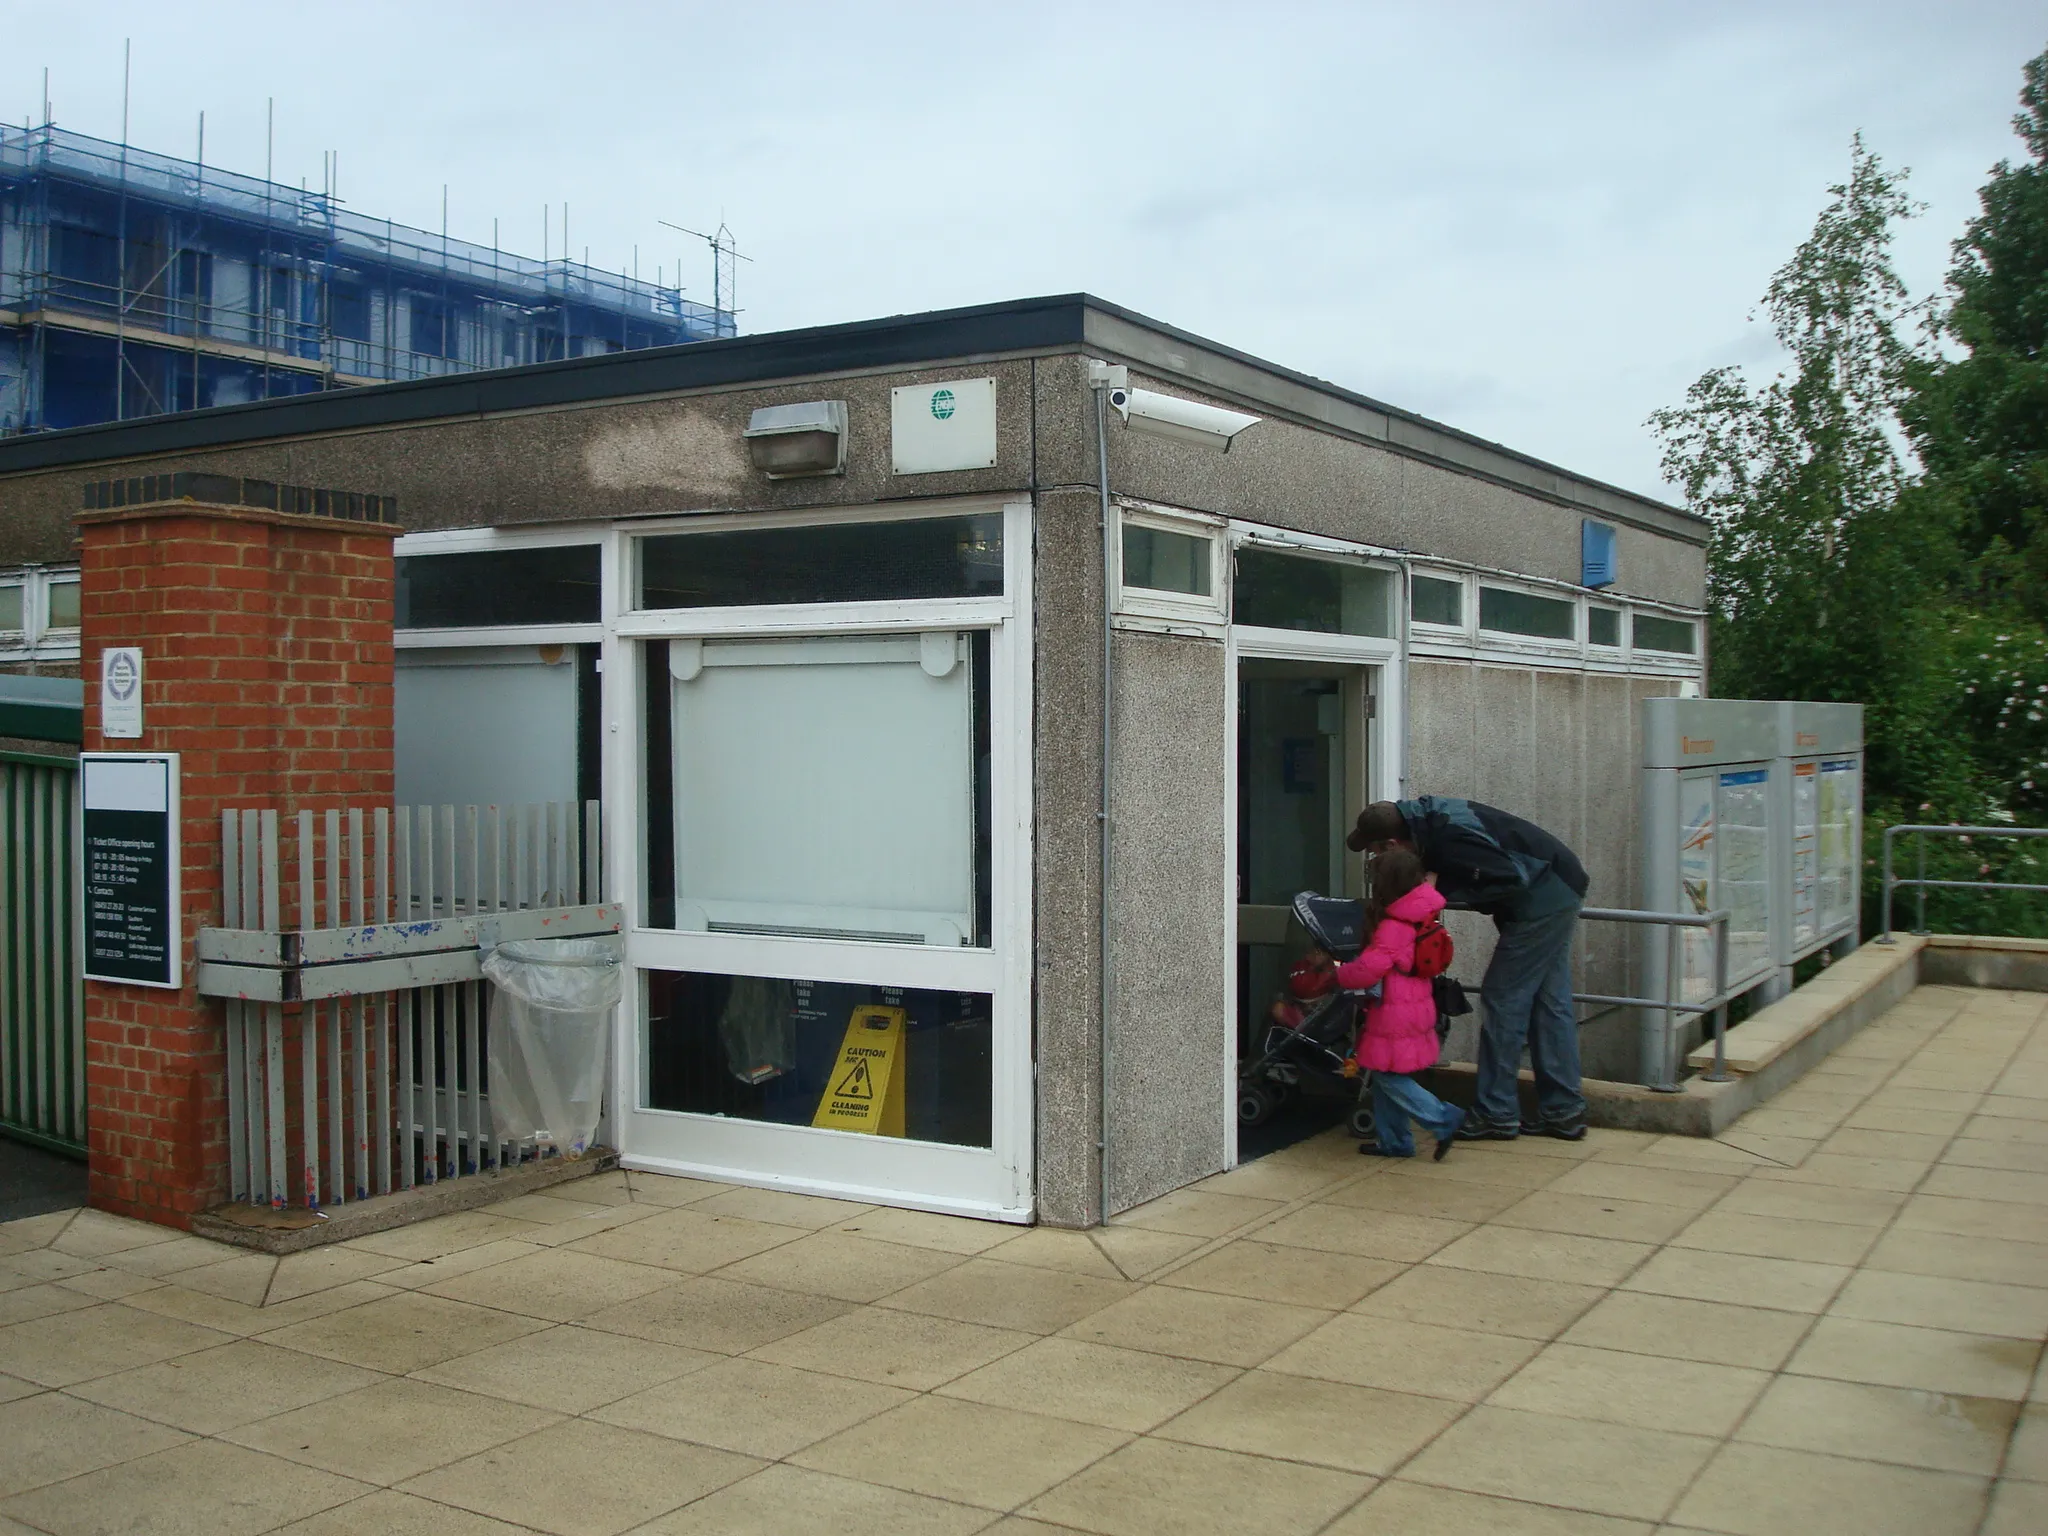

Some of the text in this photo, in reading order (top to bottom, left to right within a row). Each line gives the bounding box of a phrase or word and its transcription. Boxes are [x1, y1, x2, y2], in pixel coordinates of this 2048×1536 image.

[93, 837, 155, 849] Ticket Office opening hours
[94, 886, 114, 896] Contacts
[882, 986, 904, 996] Please
[886, 996, 900, 1006] take
[847, 1047, 886, 1058] CAUTION
[832, 1101, 870, 1111] CLEANING
